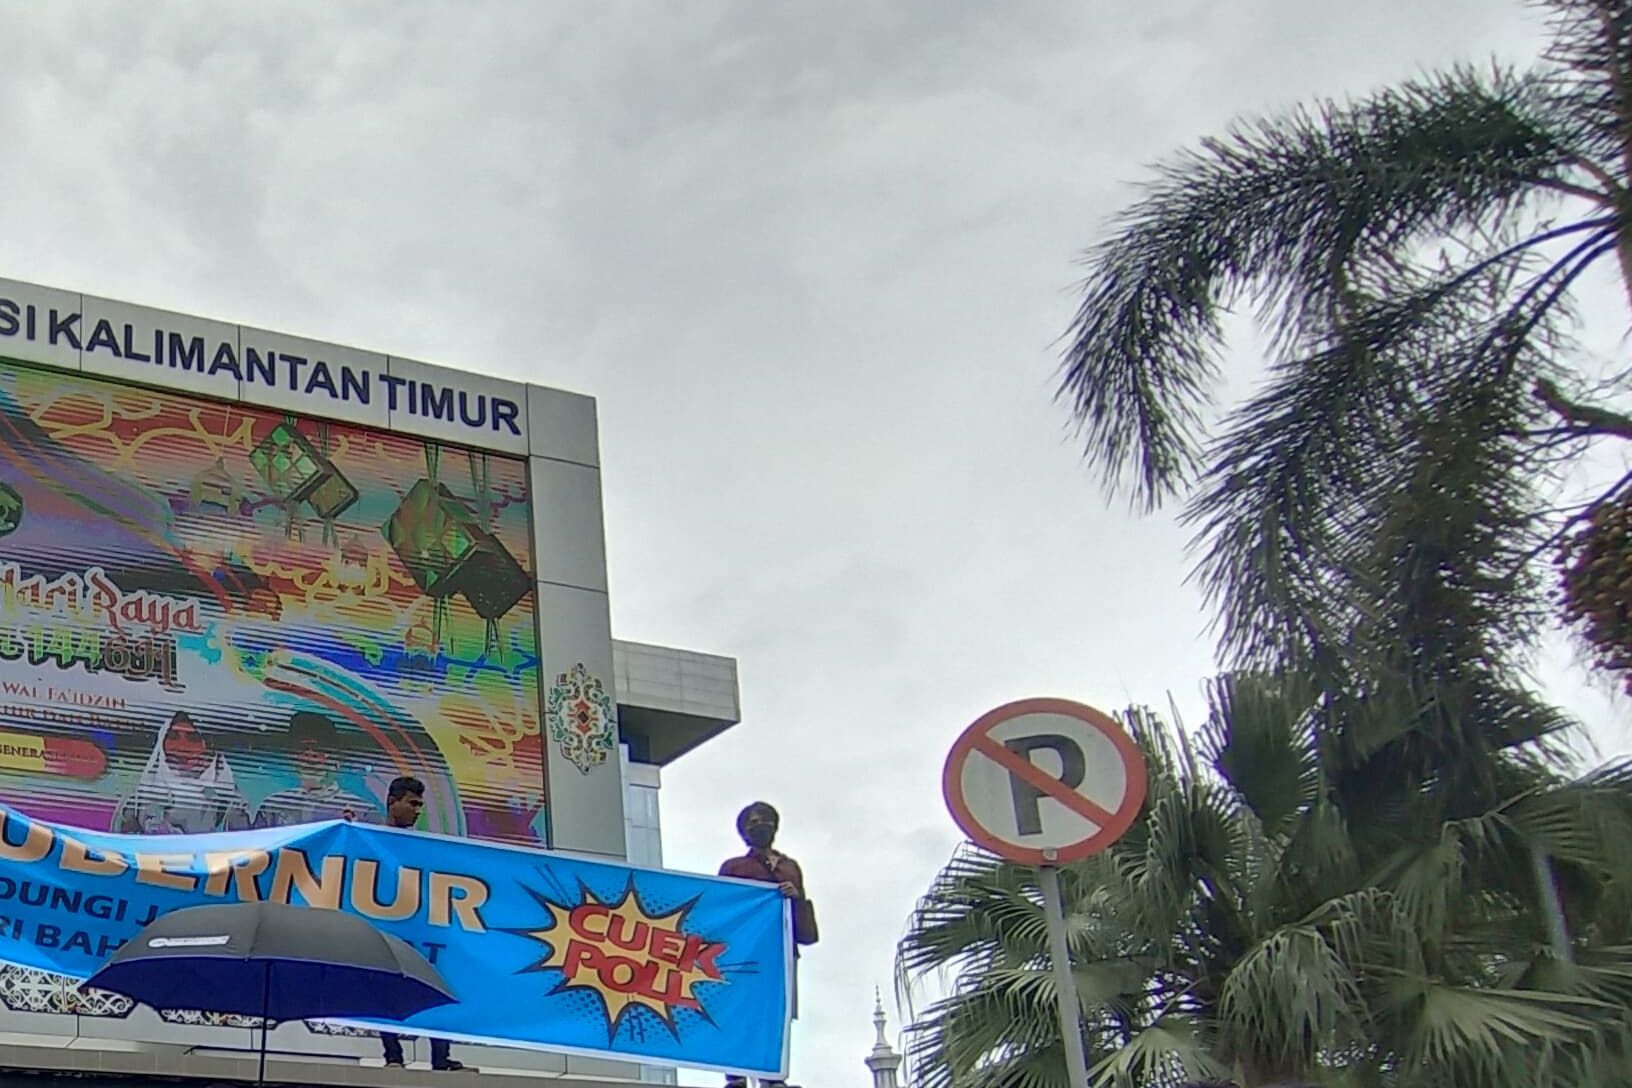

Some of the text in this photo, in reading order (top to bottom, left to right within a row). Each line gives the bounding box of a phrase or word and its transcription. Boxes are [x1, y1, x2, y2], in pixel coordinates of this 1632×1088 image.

[48, 308, 370, 405] KALIMANTAN
[378, 373, 523, 437] TIMUR
[88, 570, 202, 635] Raya
[1004, 734, 1086, 836] P
[563, 939, 700, 1009] POLL
[569, 903, 727, 980] CUEK
